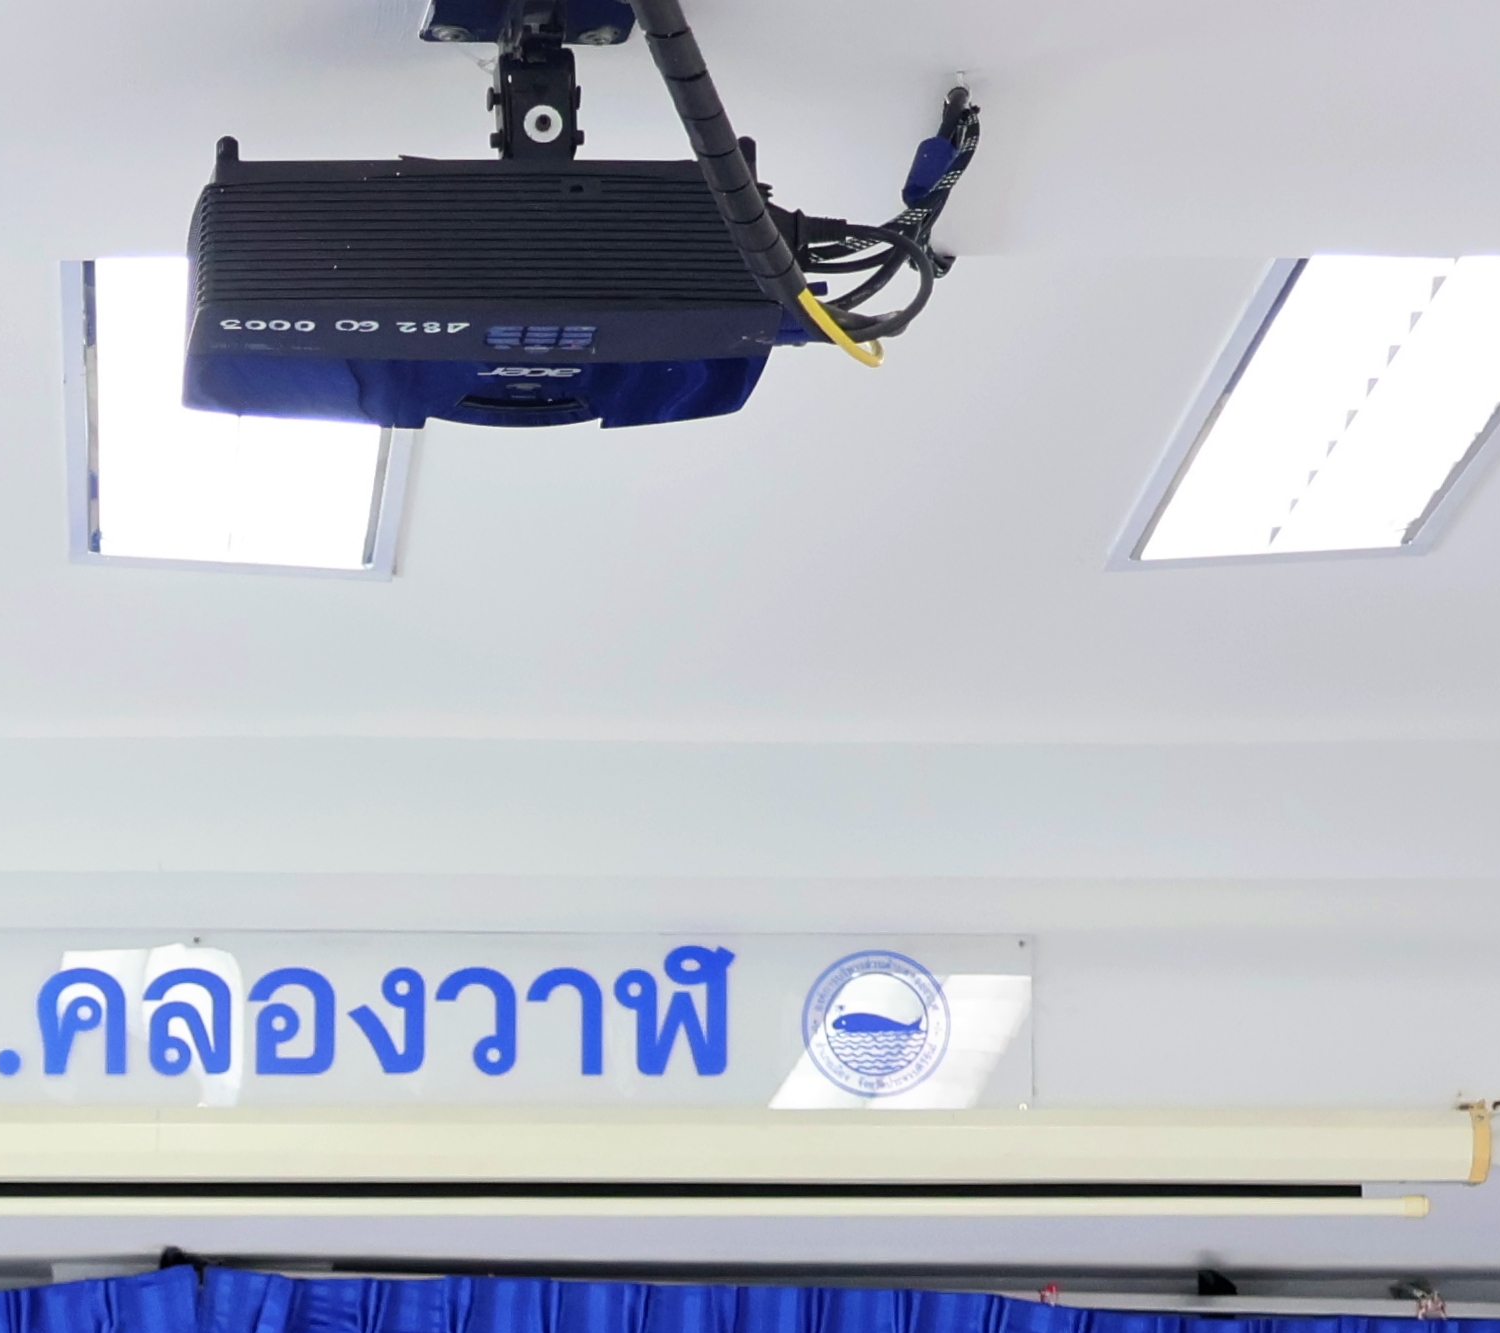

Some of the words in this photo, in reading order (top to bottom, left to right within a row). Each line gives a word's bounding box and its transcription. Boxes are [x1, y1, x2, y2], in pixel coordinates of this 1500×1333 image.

[218, 318, 317, 333] 0003
[395, 320, 472, 335] 482
[477, 366, 583, 379] acer
